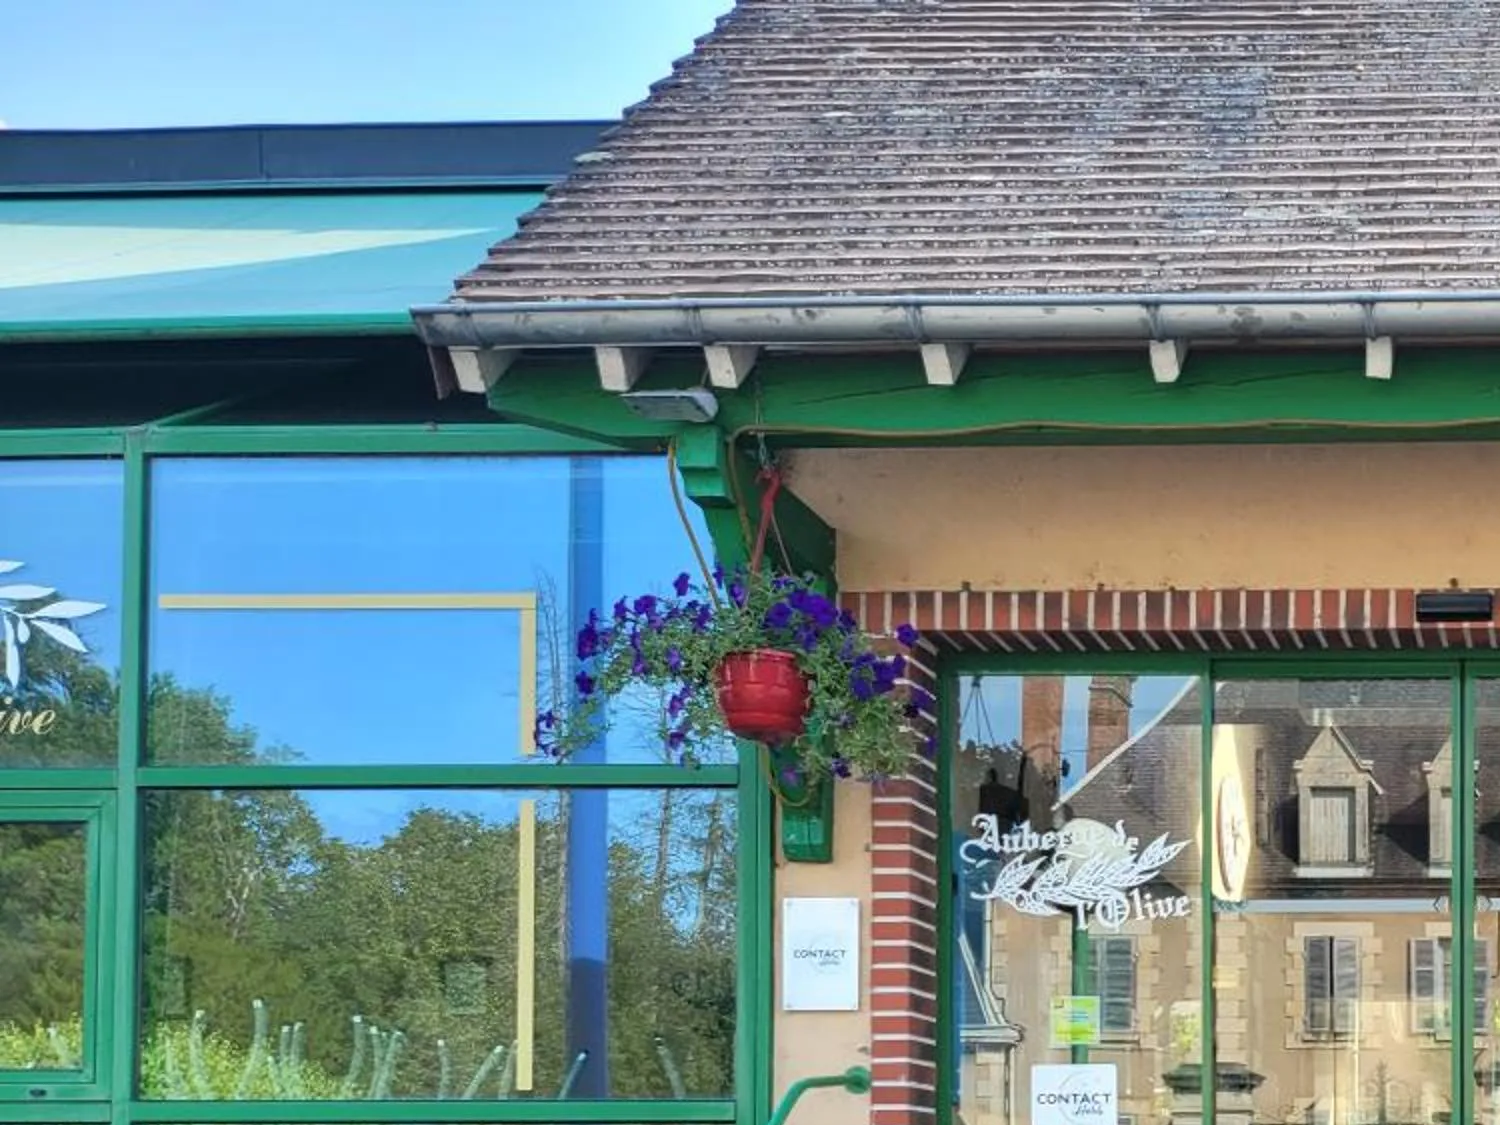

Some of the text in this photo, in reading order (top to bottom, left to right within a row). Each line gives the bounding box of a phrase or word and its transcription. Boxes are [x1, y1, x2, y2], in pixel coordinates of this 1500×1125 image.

[1076, 887, 1191, 932] l'Olive
[793, 949, 847, 959] CONTACT
[1037, 1093, 1112, 1105] CONTACT
